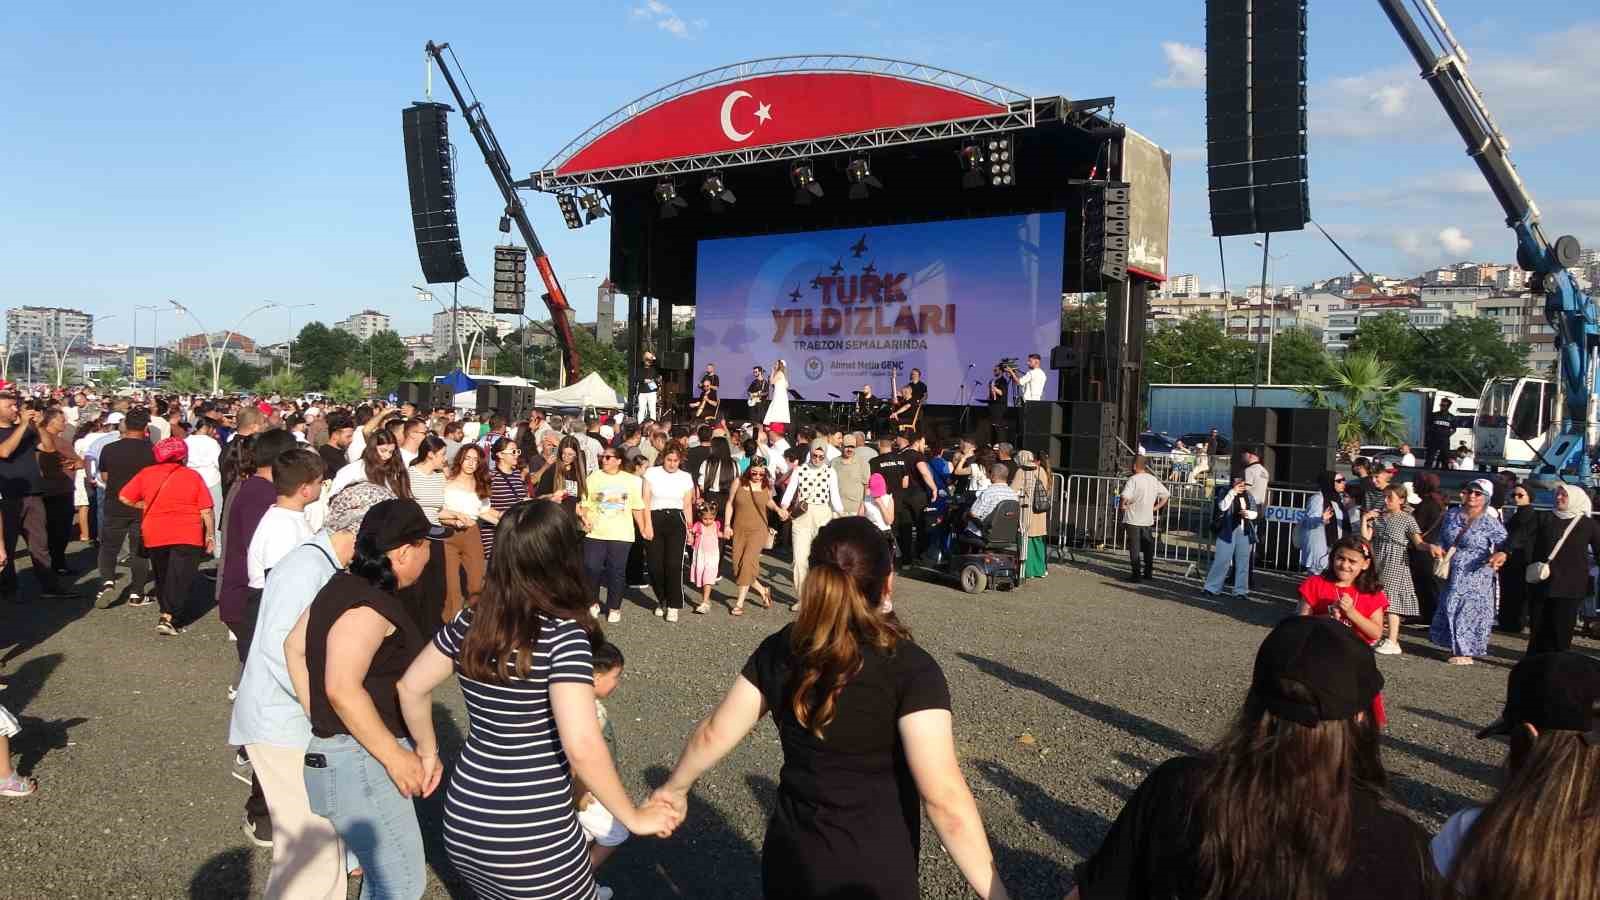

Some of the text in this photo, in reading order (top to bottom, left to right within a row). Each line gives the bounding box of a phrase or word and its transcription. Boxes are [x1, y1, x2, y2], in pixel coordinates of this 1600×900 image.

[771, 304, 956, 342] YILDIZLARI
[793, 339, 928, 351] TRABZON SEMALARINDA
